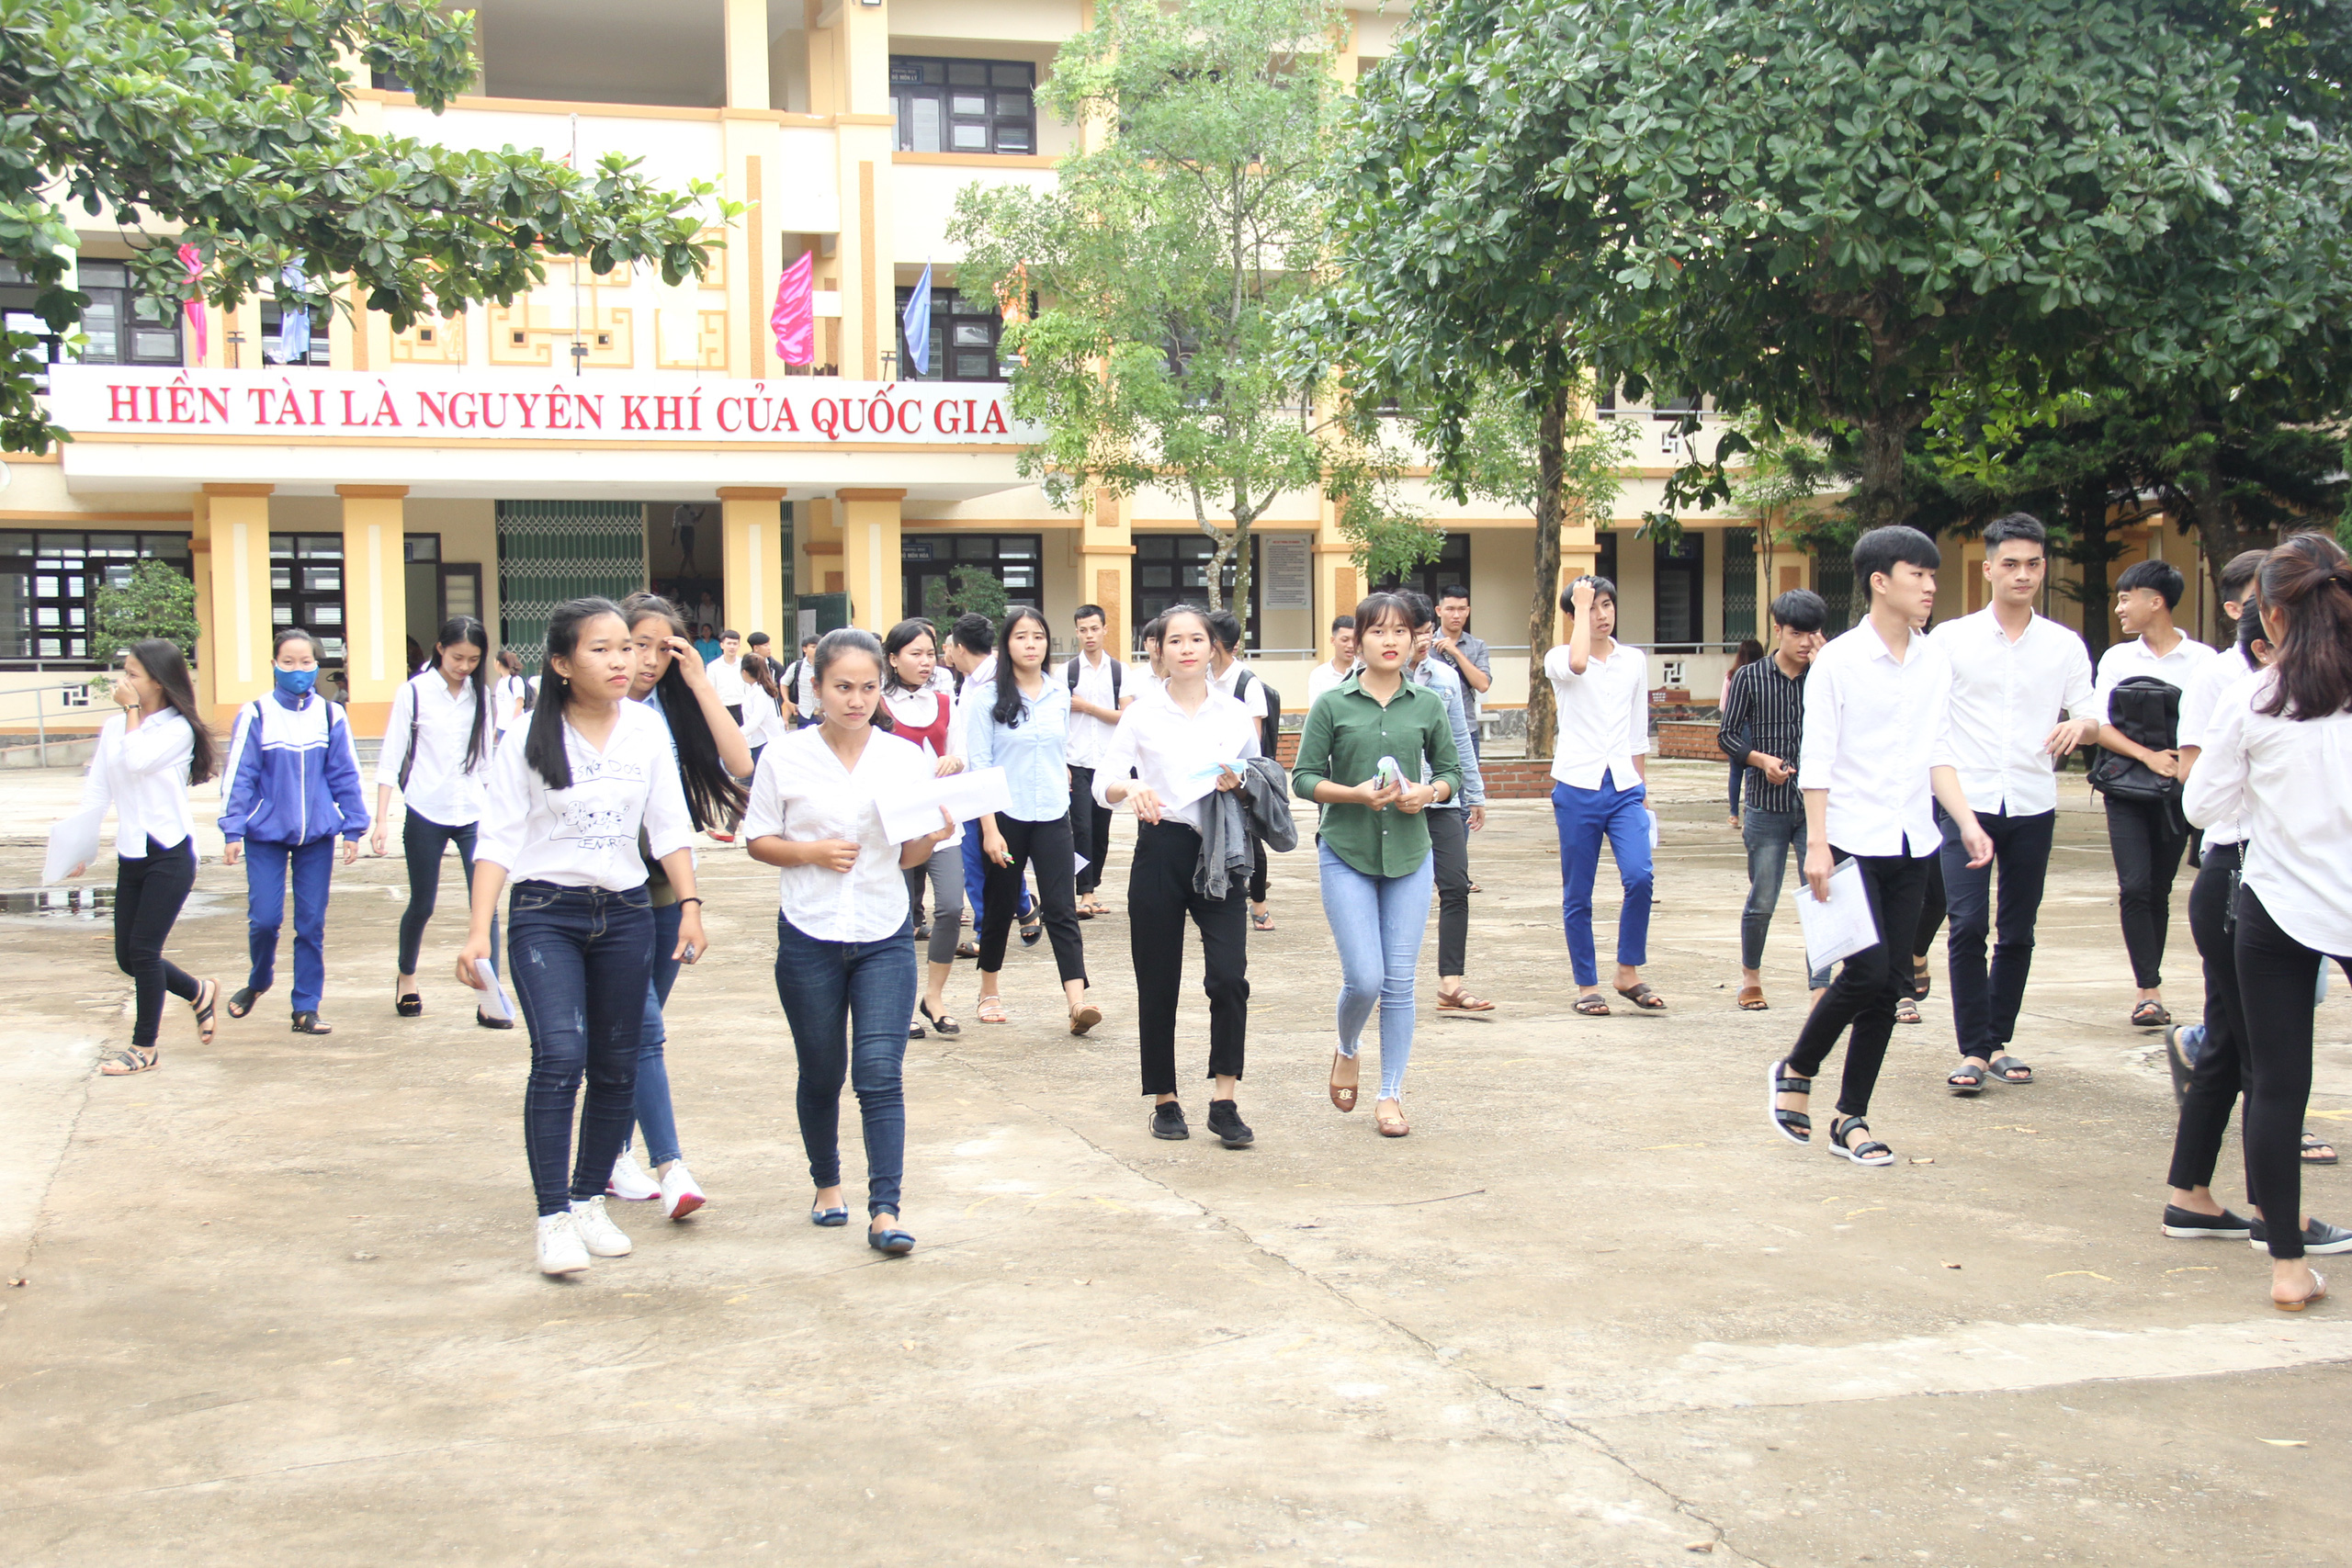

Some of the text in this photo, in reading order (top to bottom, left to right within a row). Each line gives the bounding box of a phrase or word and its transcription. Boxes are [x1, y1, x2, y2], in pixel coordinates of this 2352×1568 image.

[107, 369, 1008, 441] HIỀN TÀI LÀ NGUYÊN KHÍ CỦA QUỐC GIA
